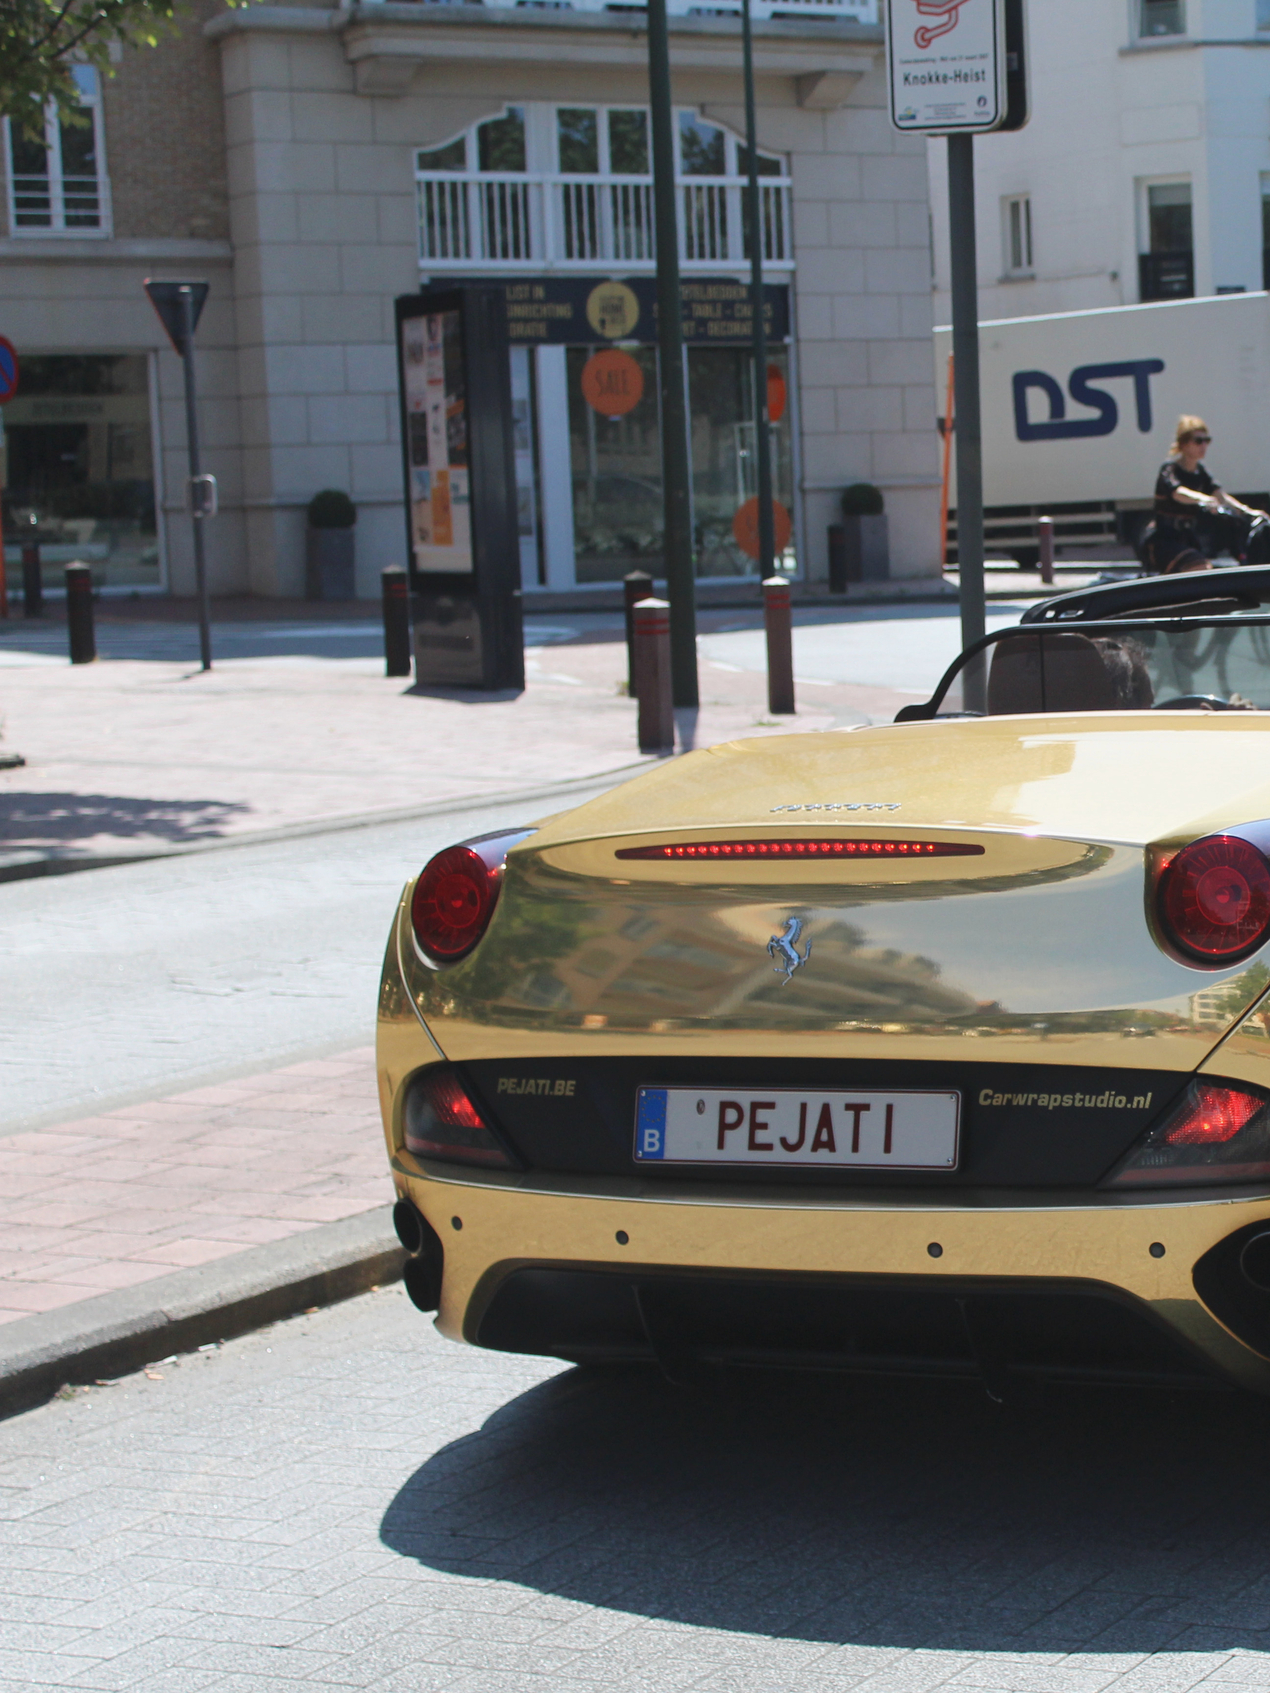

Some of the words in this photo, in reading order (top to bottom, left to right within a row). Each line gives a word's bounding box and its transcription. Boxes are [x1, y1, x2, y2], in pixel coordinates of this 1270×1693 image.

[903, 69, 986, 86] Knokke-Heist
[595, 368, 631, 398] SALE
[1012, 358, 1165, 442] DST
[497, 1077, 577, 1097] PEJATI.BE
[978, 1088, 1153, 1110] Carwrapstudio.nl
[643, 1128, 660, 1153] B
[717, 1100, 894, 1155] PEJATI
